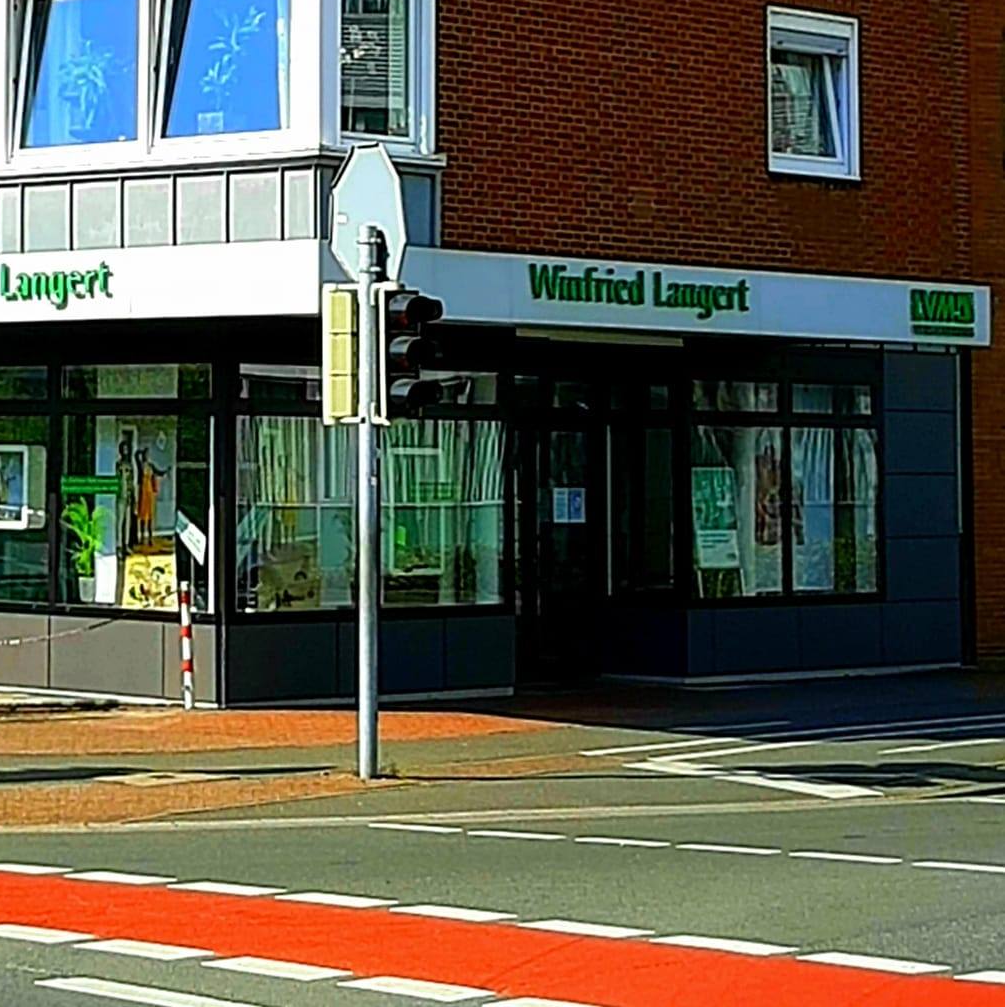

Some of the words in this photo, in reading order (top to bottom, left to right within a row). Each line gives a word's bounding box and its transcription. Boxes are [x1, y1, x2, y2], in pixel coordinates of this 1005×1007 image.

[0, 261, 113, 310] Langert
[529, 263, 645, 305] Winfried
[653, 272, 749, 319] Langert
[910, 289, 958, 322] LVM
